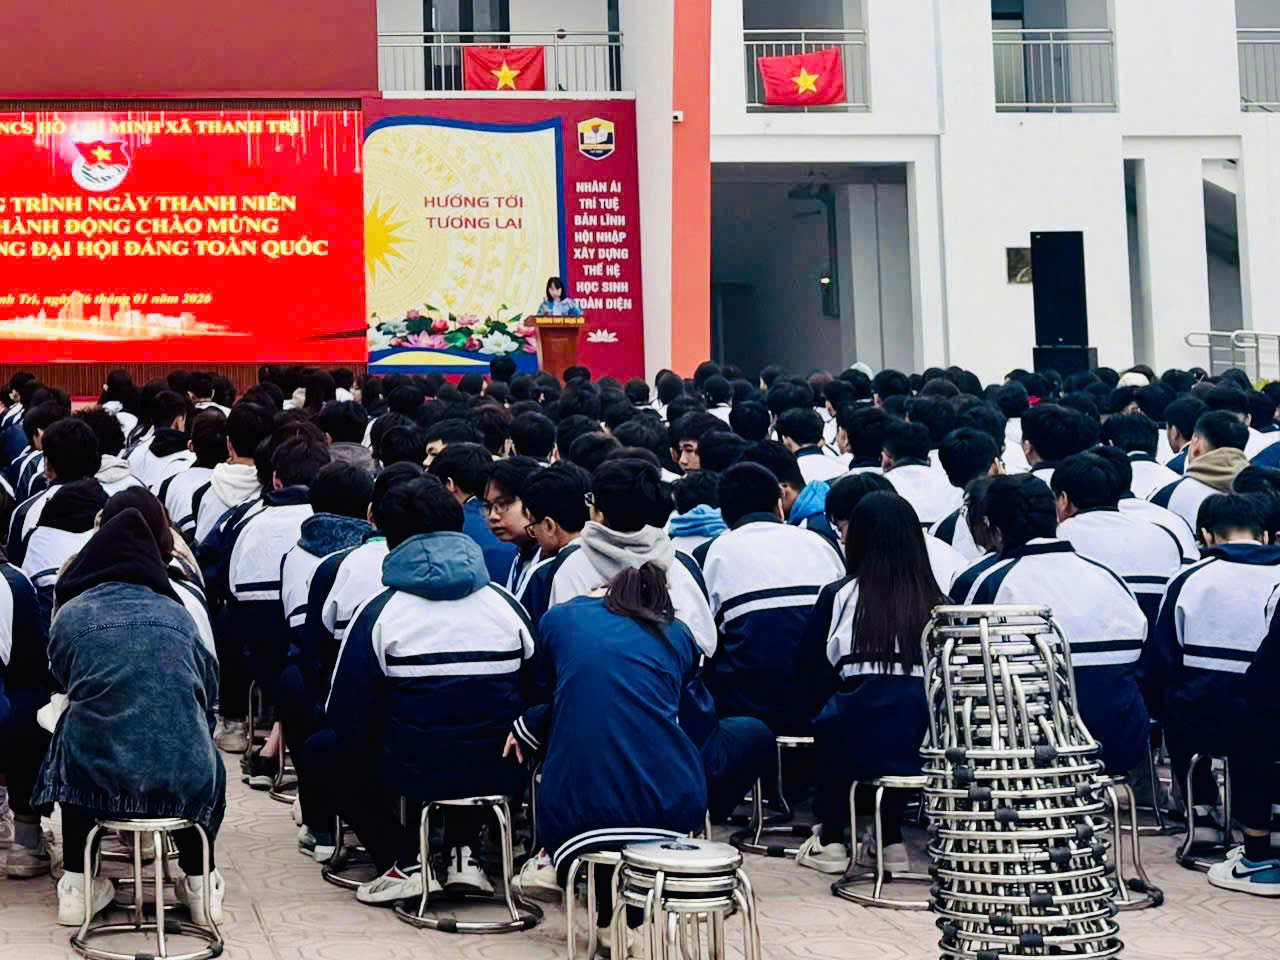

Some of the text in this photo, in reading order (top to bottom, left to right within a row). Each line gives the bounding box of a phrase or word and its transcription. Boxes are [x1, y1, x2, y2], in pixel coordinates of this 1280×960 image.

[165, 117, 193, 134] XÃ
[196, 120, 263, 134] THANH
[576, 180, 608, 193] NHÂN
[10, 192, 83, 212] TRÌNH
[87, 192, 152, 212] NGÀY
[155, 195, 237, 211] THANH
[241, 192, 297, 211] NIÊN
[423, 192, 524, 209] HƯỚNG TỚI
[578, 196, 597, 209] TRÍ
[65, 217, 131, 238] ĐỘNG
[135, 214, 203, 234] CHÀO
[207, 214, 280, 234] MỪNG
[425, 215, 523, 229] TƯƠNG LAI
[574, 229, 627, 245] HỘI NHẬP
[31, 241, 71, 260] ĐẠI
[77, 239, 119, 260] HỘI
[124, 237, 189, 257] ĐẢNG
[193, 236, 257, 257] TOÀN
[261, 235, 330, 259] QUỐC
[573, 246, 629, 261] XÂY DỰNG
[582, 261, 621, 278] THẾ HỆ
[576, 281, 629, 295] HỌC SINH
[574, 296, 632, 311] TOÀN DIỆN
